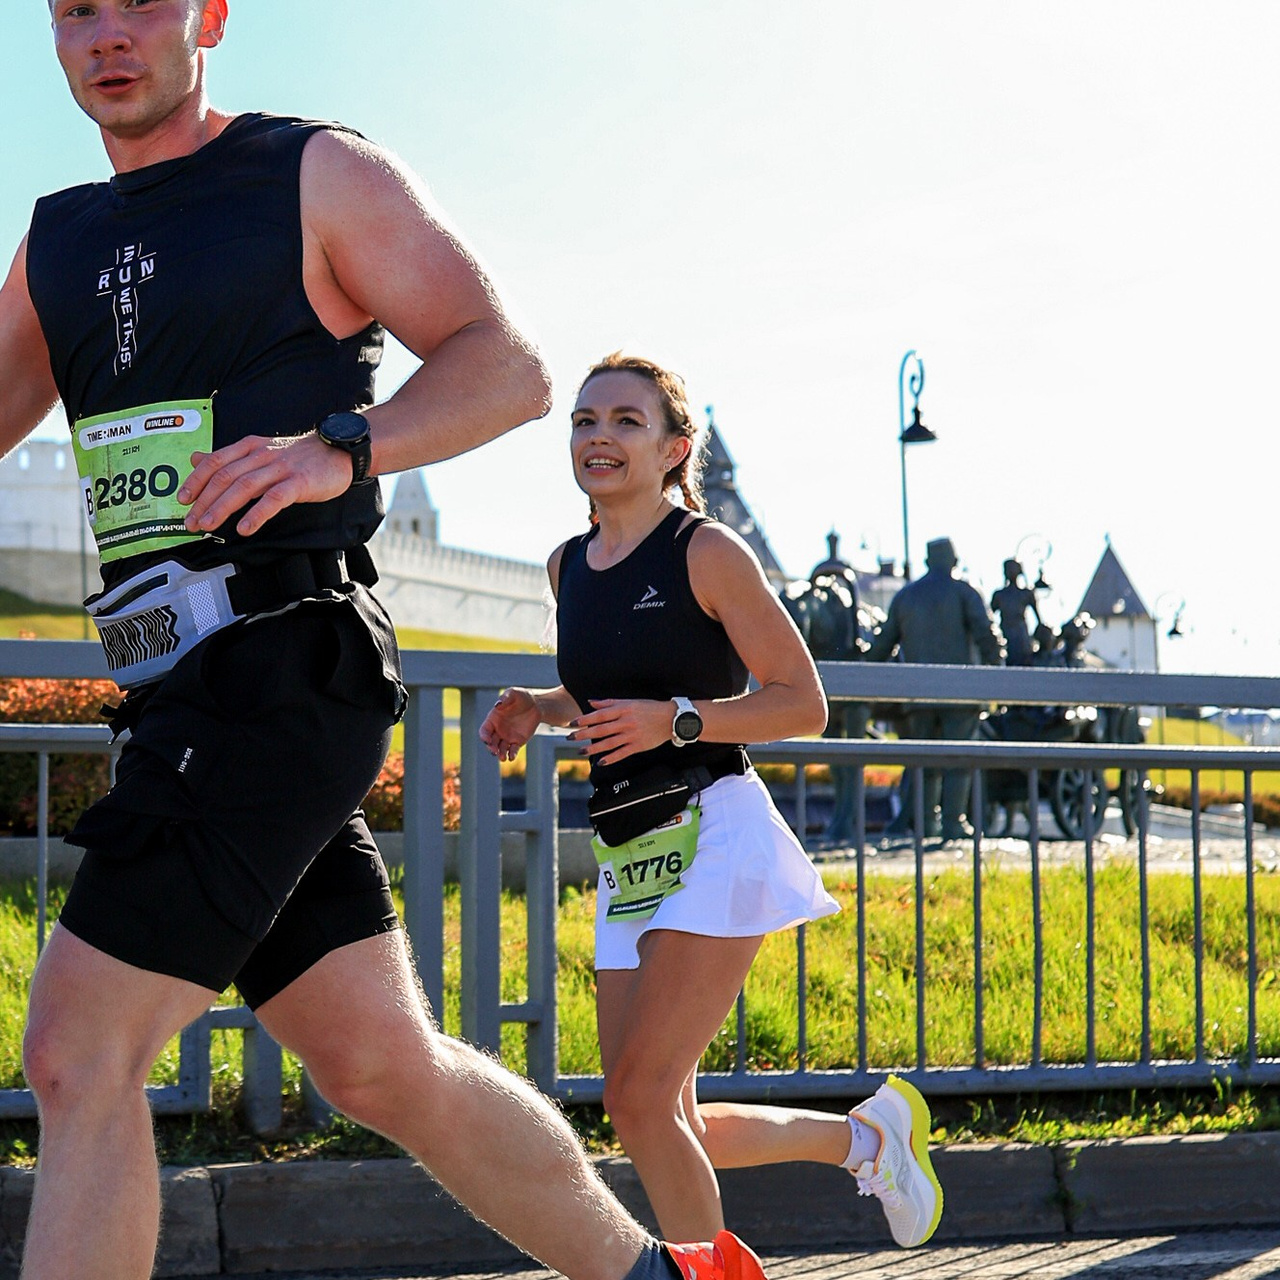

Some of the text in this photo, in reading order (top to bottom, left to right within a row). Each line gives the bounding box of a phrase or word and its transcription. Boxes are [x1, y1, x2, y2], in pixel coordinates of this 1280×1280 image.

[120, 287, 133, 315] WE
[146, 417, 175, 429] WINLINE
[85, 464, 179, 516] B 2380
[633, 600, 666, 610] DEMIX
[604, 851, 682, 890] B 1776
